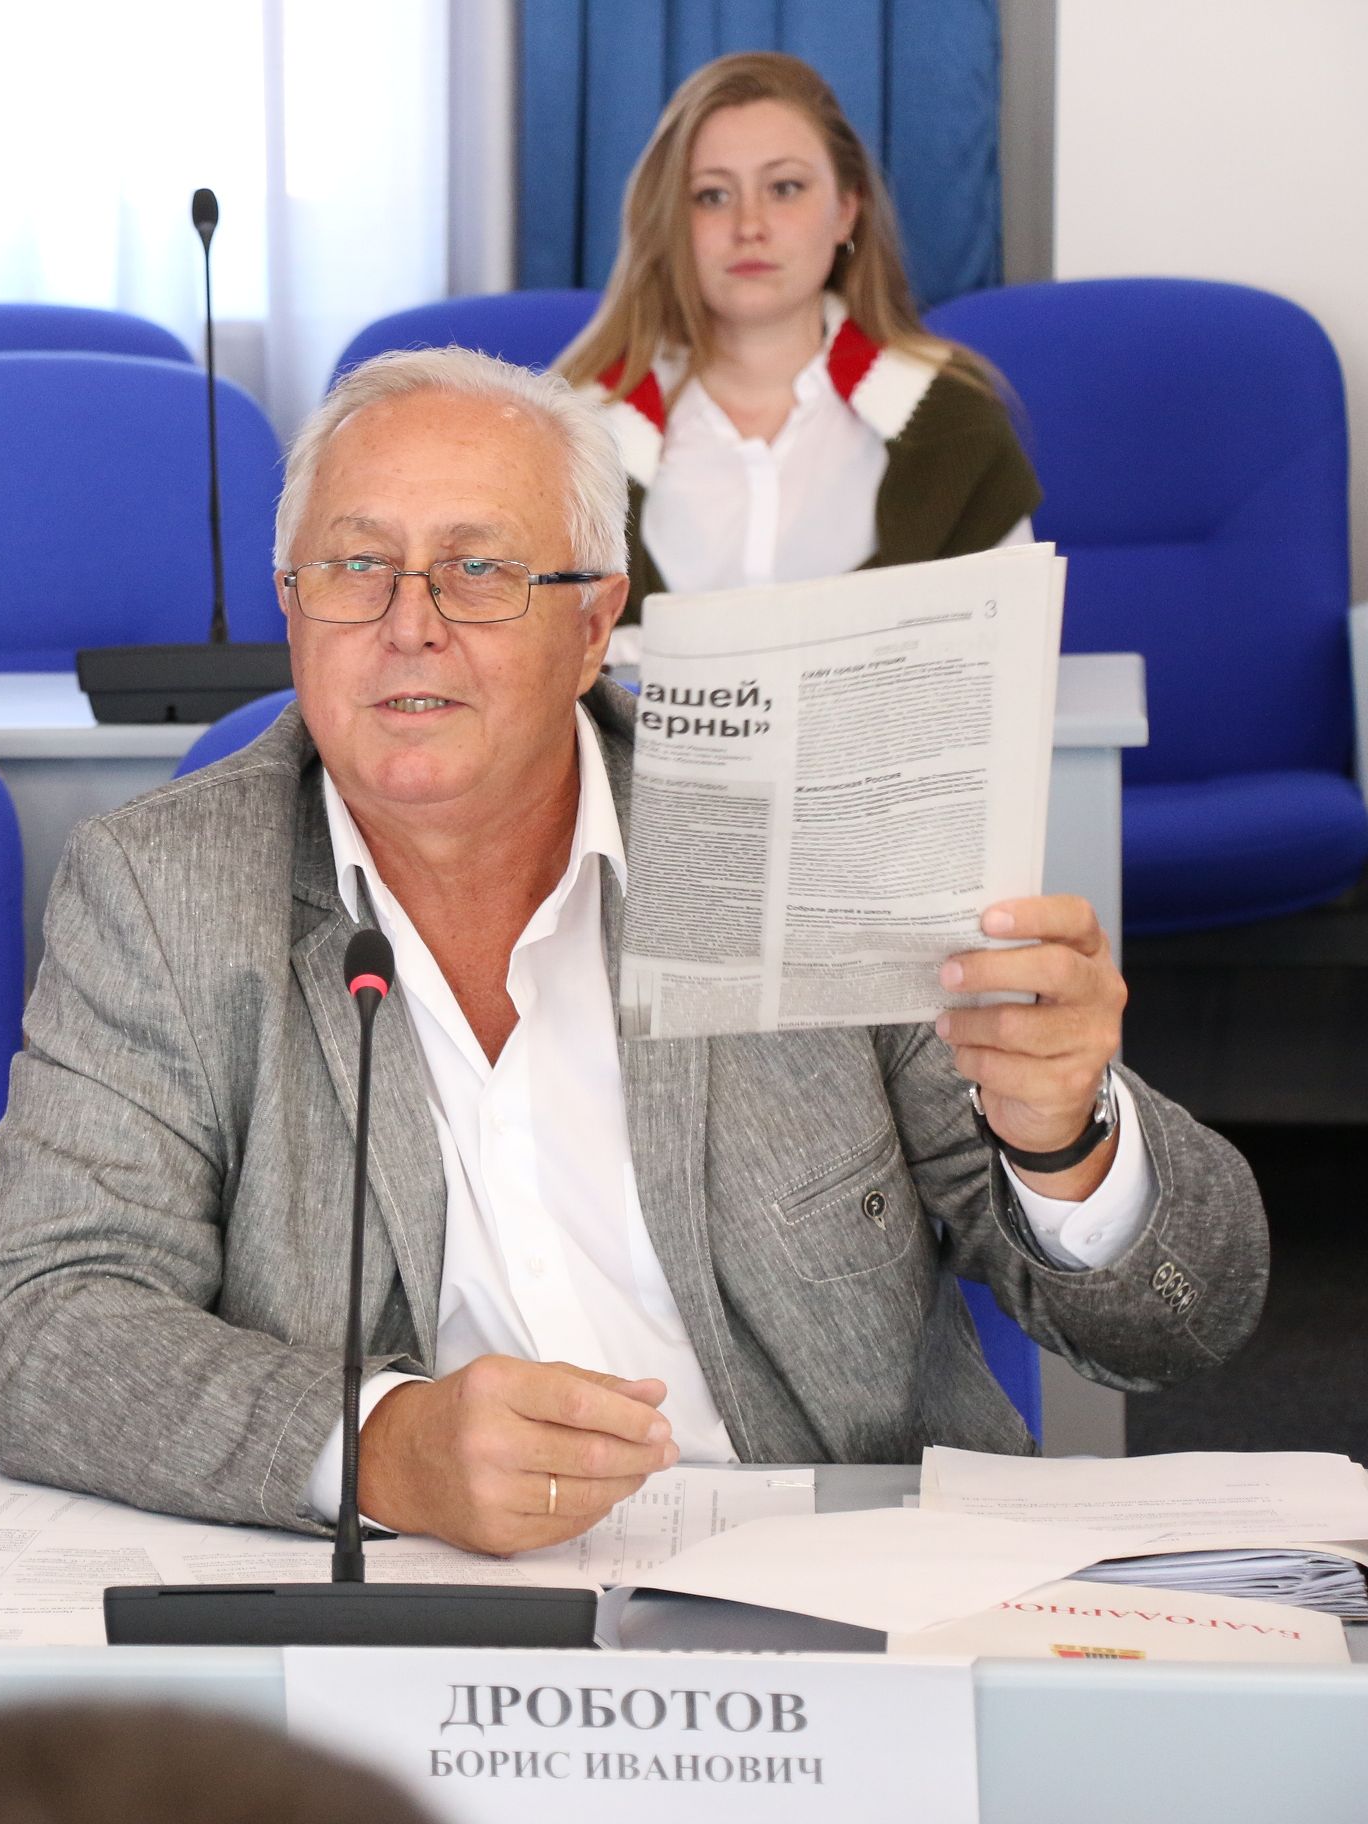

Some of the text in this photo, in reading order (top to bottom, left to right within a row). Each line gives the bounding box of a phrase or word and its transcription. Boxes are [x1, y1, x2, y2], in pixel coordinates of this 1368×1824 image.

[984, 599, 998, 619] 3
[645, 679, 773, 712] ашей,
[641, 711, 770, 738] ерны»
[439, 1683, 809, 1737] ДРОБОТОВ
[428, 1748, 826, 1786] БОРИС ИВАНОВИЧ
